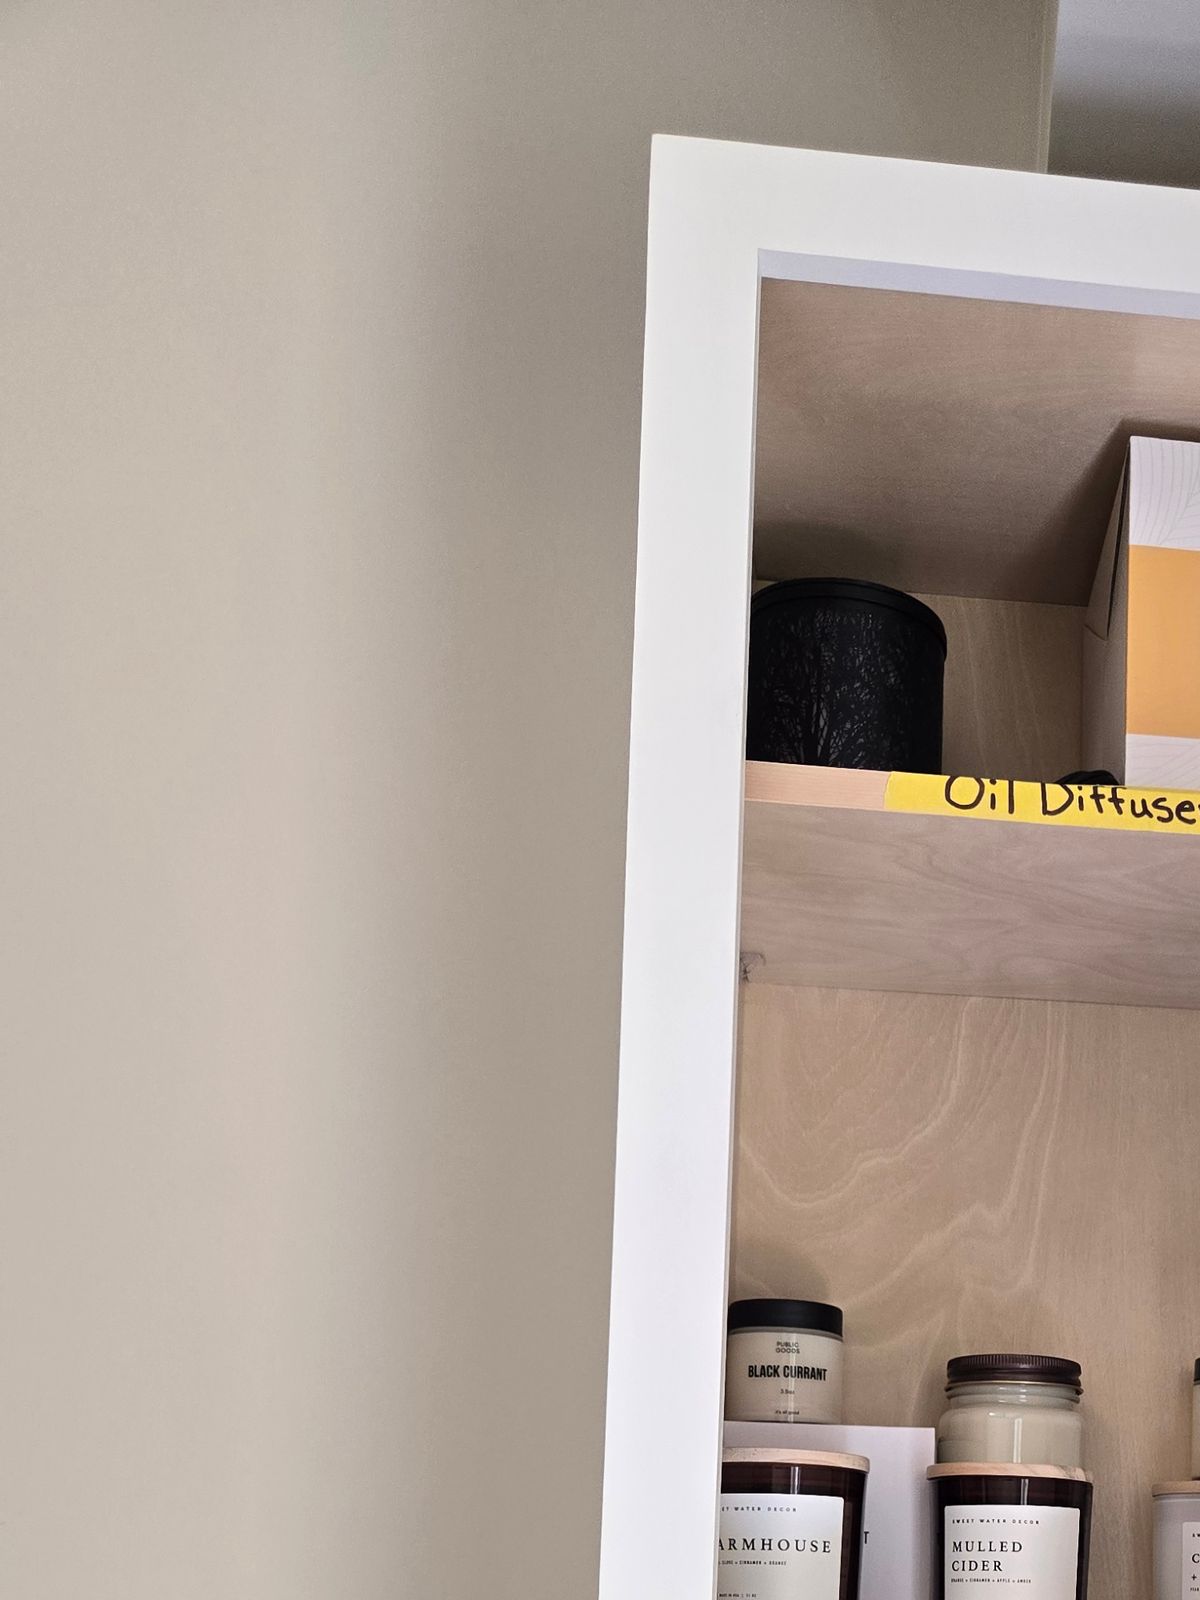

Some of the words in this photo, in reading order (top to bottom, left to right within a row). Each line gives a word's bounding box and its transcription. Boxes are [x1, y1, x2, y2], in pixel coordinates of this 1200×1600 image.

[943, 774, 1014, 815] Oil
[748, 1364, 780, 1378] BLACK
[783, 1365, 828, 1381] CURRANT
[952, 1541, 1022, 1552] MULLED
[951, 1560, 1003, 1571] CIDER
